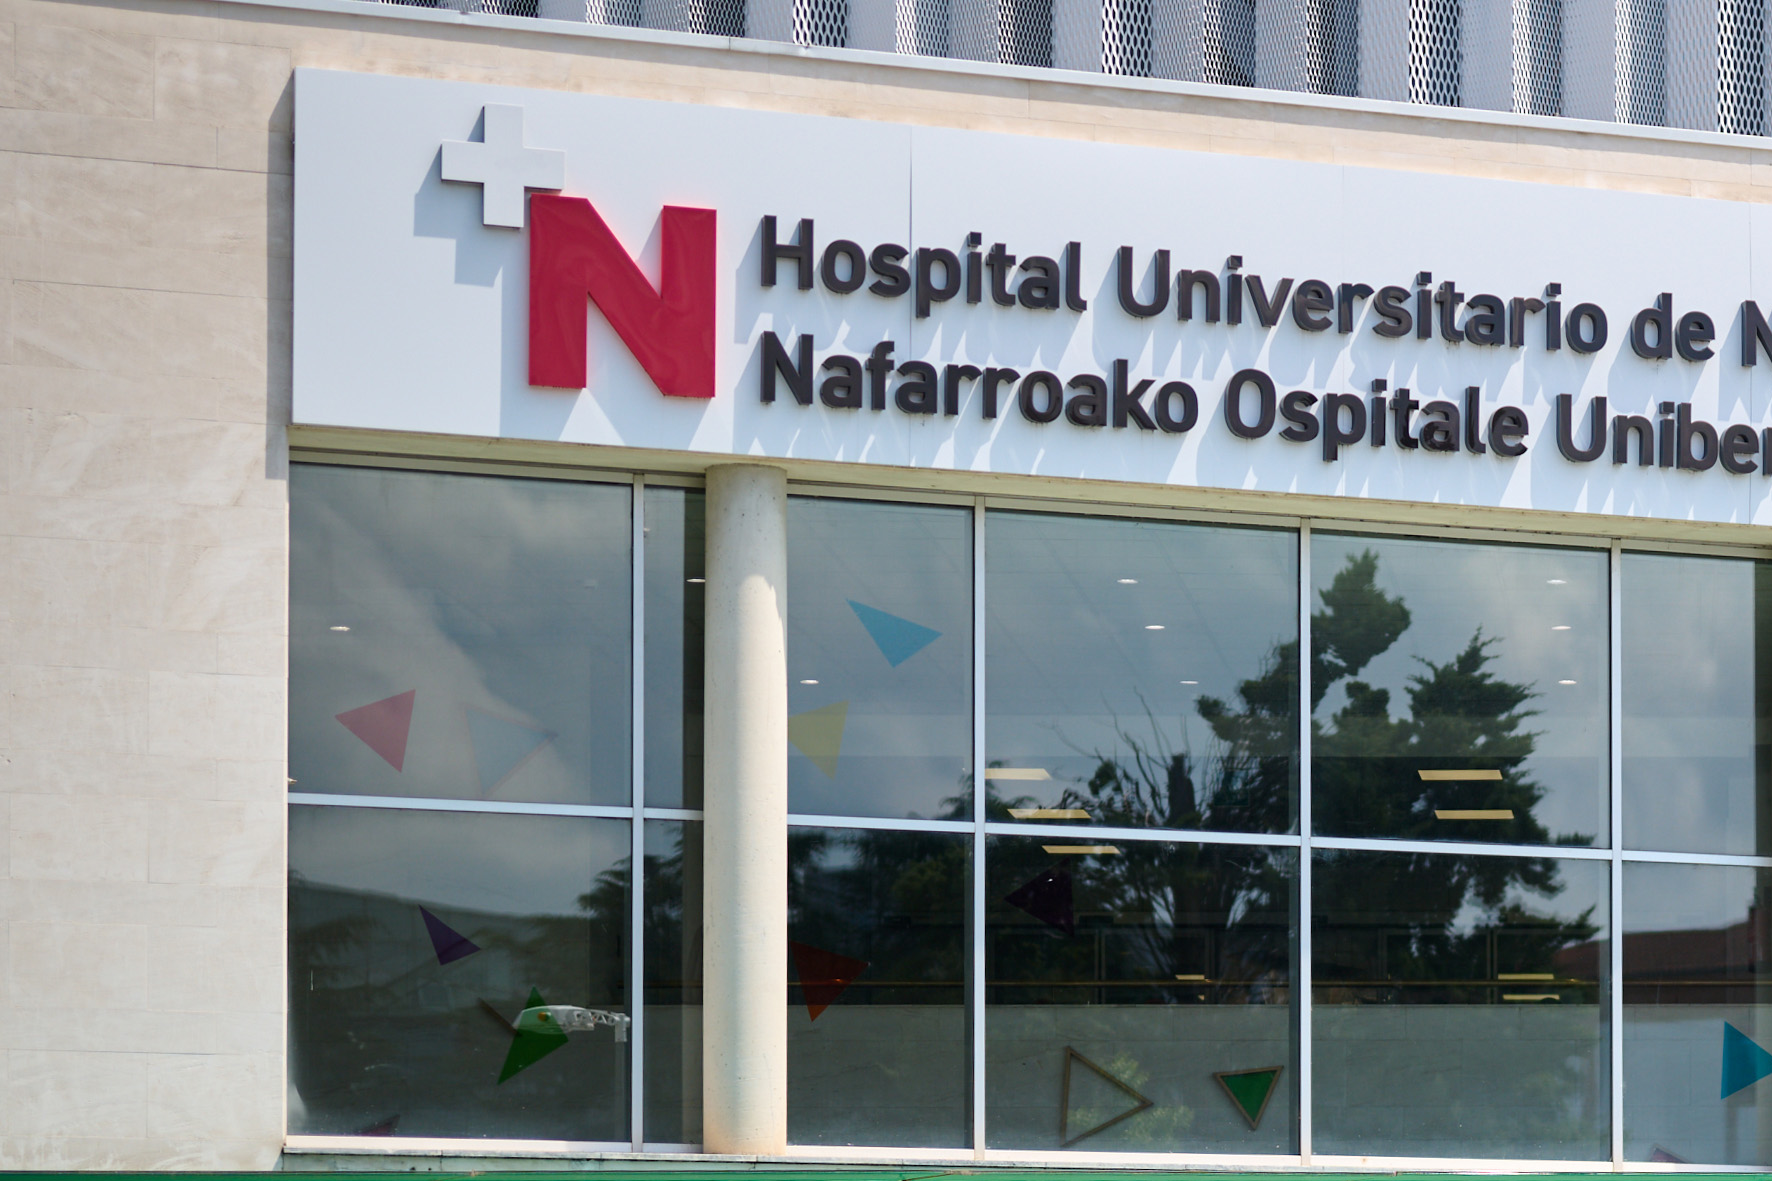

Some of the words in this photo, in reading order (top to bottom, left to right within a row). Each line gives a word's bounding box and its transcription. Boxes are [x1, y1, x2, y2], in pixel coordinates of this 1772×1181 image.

[528, 192, 717, 398] N
[760, 213, 1087, 320] Hospital
[1116, 244, 1608, 355] Universitario
[1629, 292, 1716, 364] de
[759, 330, 1199, 435] Nafarroako
[1223, 367, 1529, 463] Ospitale
